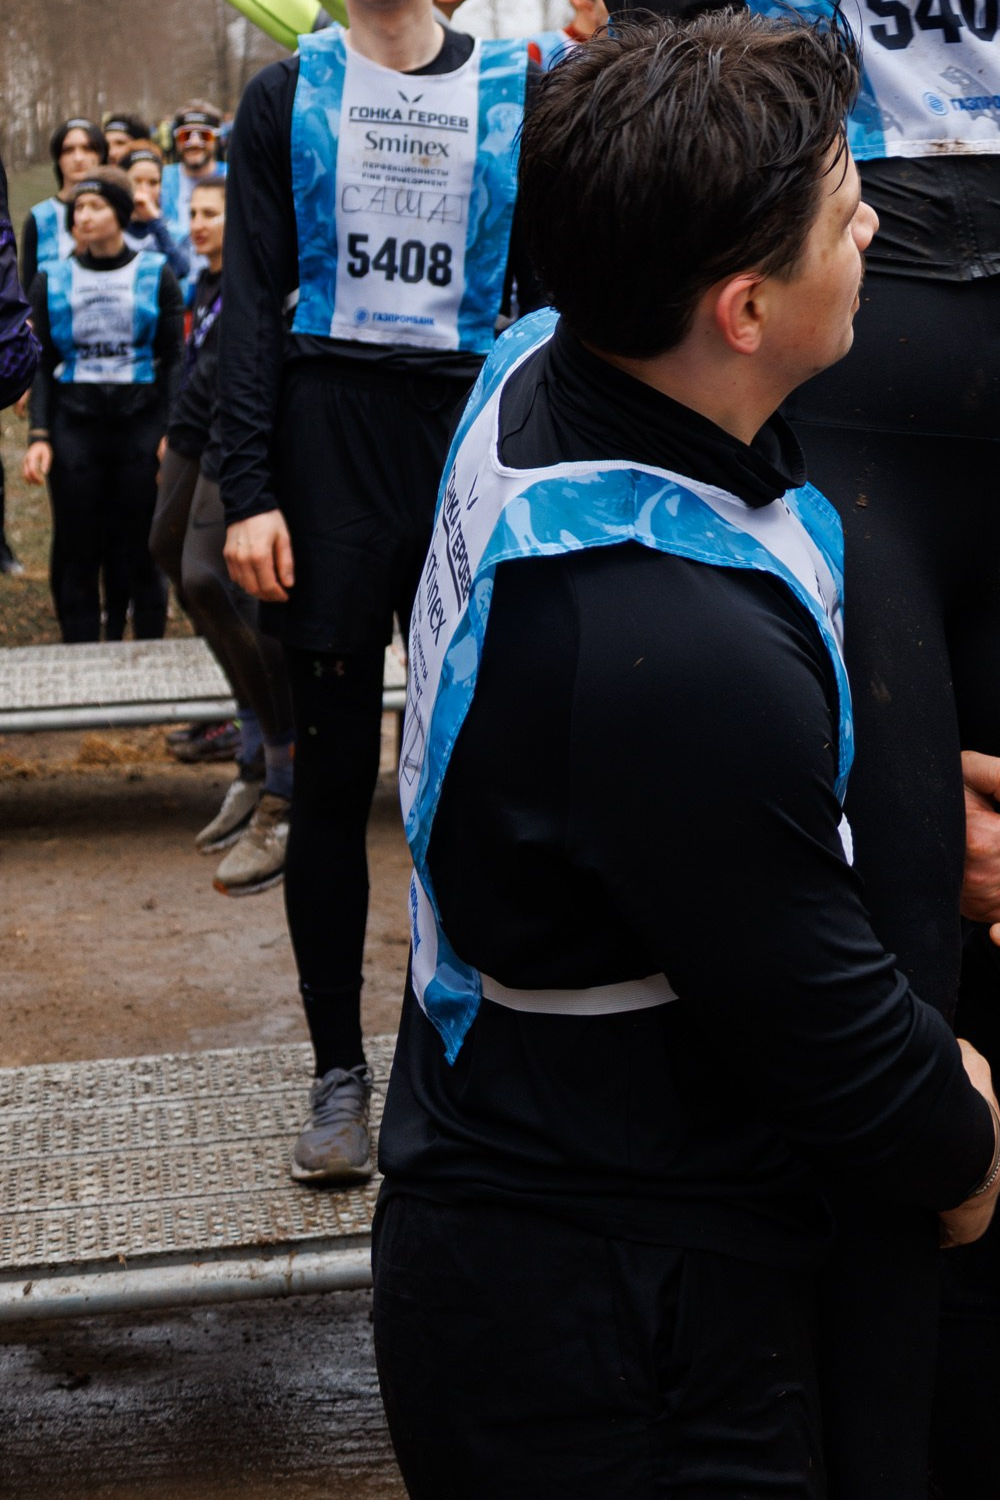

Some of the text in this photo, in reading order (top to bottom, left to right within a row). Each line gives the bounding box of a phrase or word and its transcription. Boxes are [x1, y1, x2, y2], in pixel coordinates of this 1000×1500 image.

[349, 106, 469, 129] ГОНКА ГЕРОЕВ
[364, 130, 450, 158] Sminex
[361, 171, 449, 188] FINE DEVELOPMENT
[362, 160, 450, 177] ПЕРФЕКЦИОНИСТЫ
[341, 183, 452, 225] САША
[347, 232, 453, 287] 5408
[372, 312, 435, 326] ГАЗПРОМБАНК
